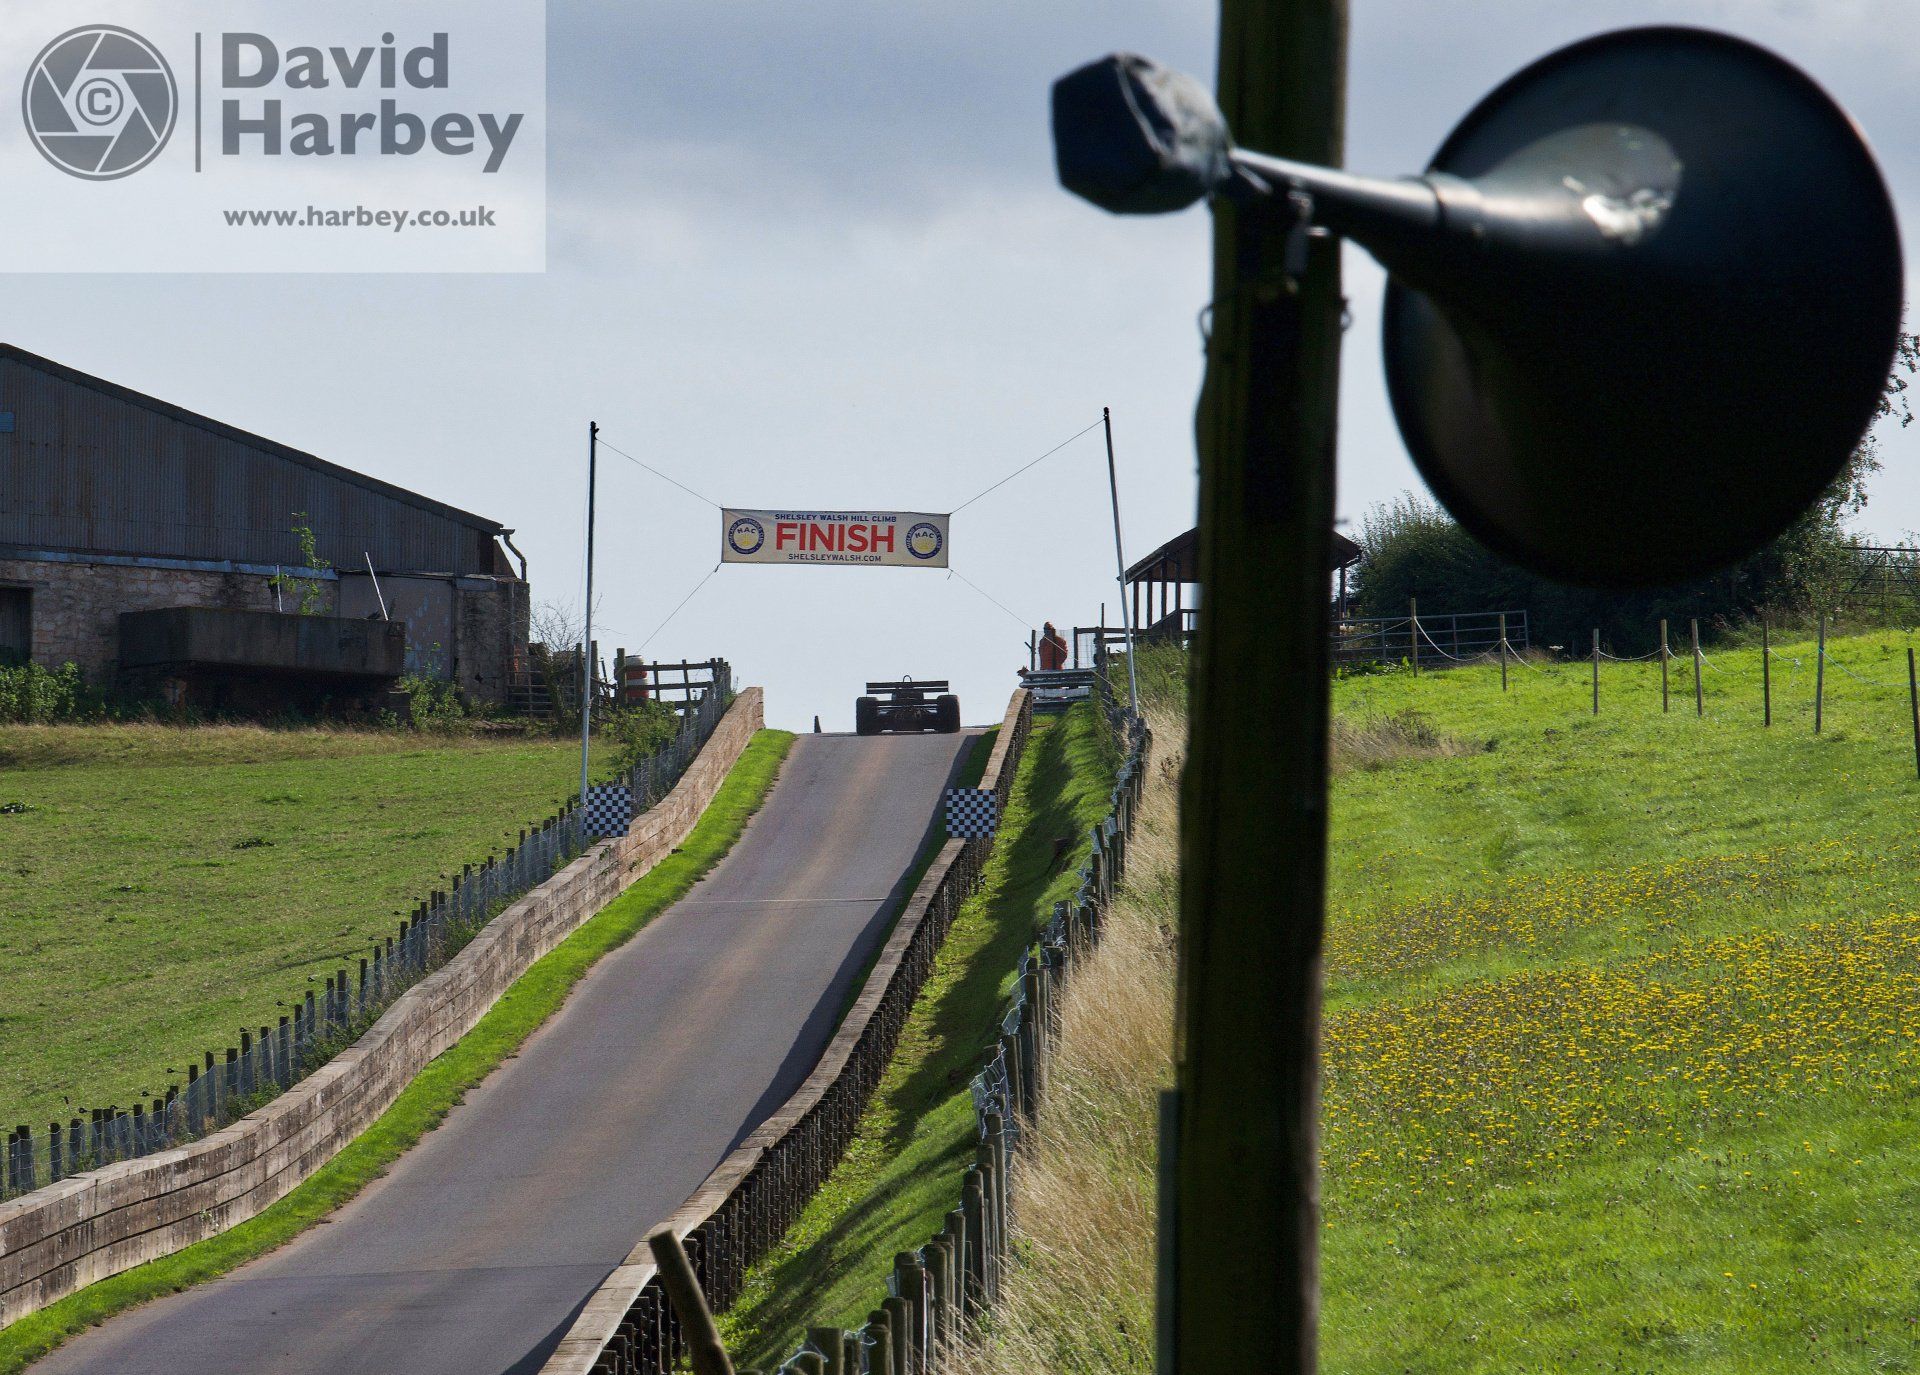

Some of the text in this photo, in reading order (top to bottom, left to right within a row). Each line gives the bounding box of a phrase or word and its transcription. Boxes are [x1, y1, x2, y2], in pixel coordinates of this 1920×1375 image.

[774, 513, 818, 521] SHELSLEY
[819, 514, 848, 522] WALSH
[871, 515, 897, 523] CLIMB
[775, 522, 895, 553] FINISH
[788, 553, 882, 562] SHELSLEYWALSH.COM
